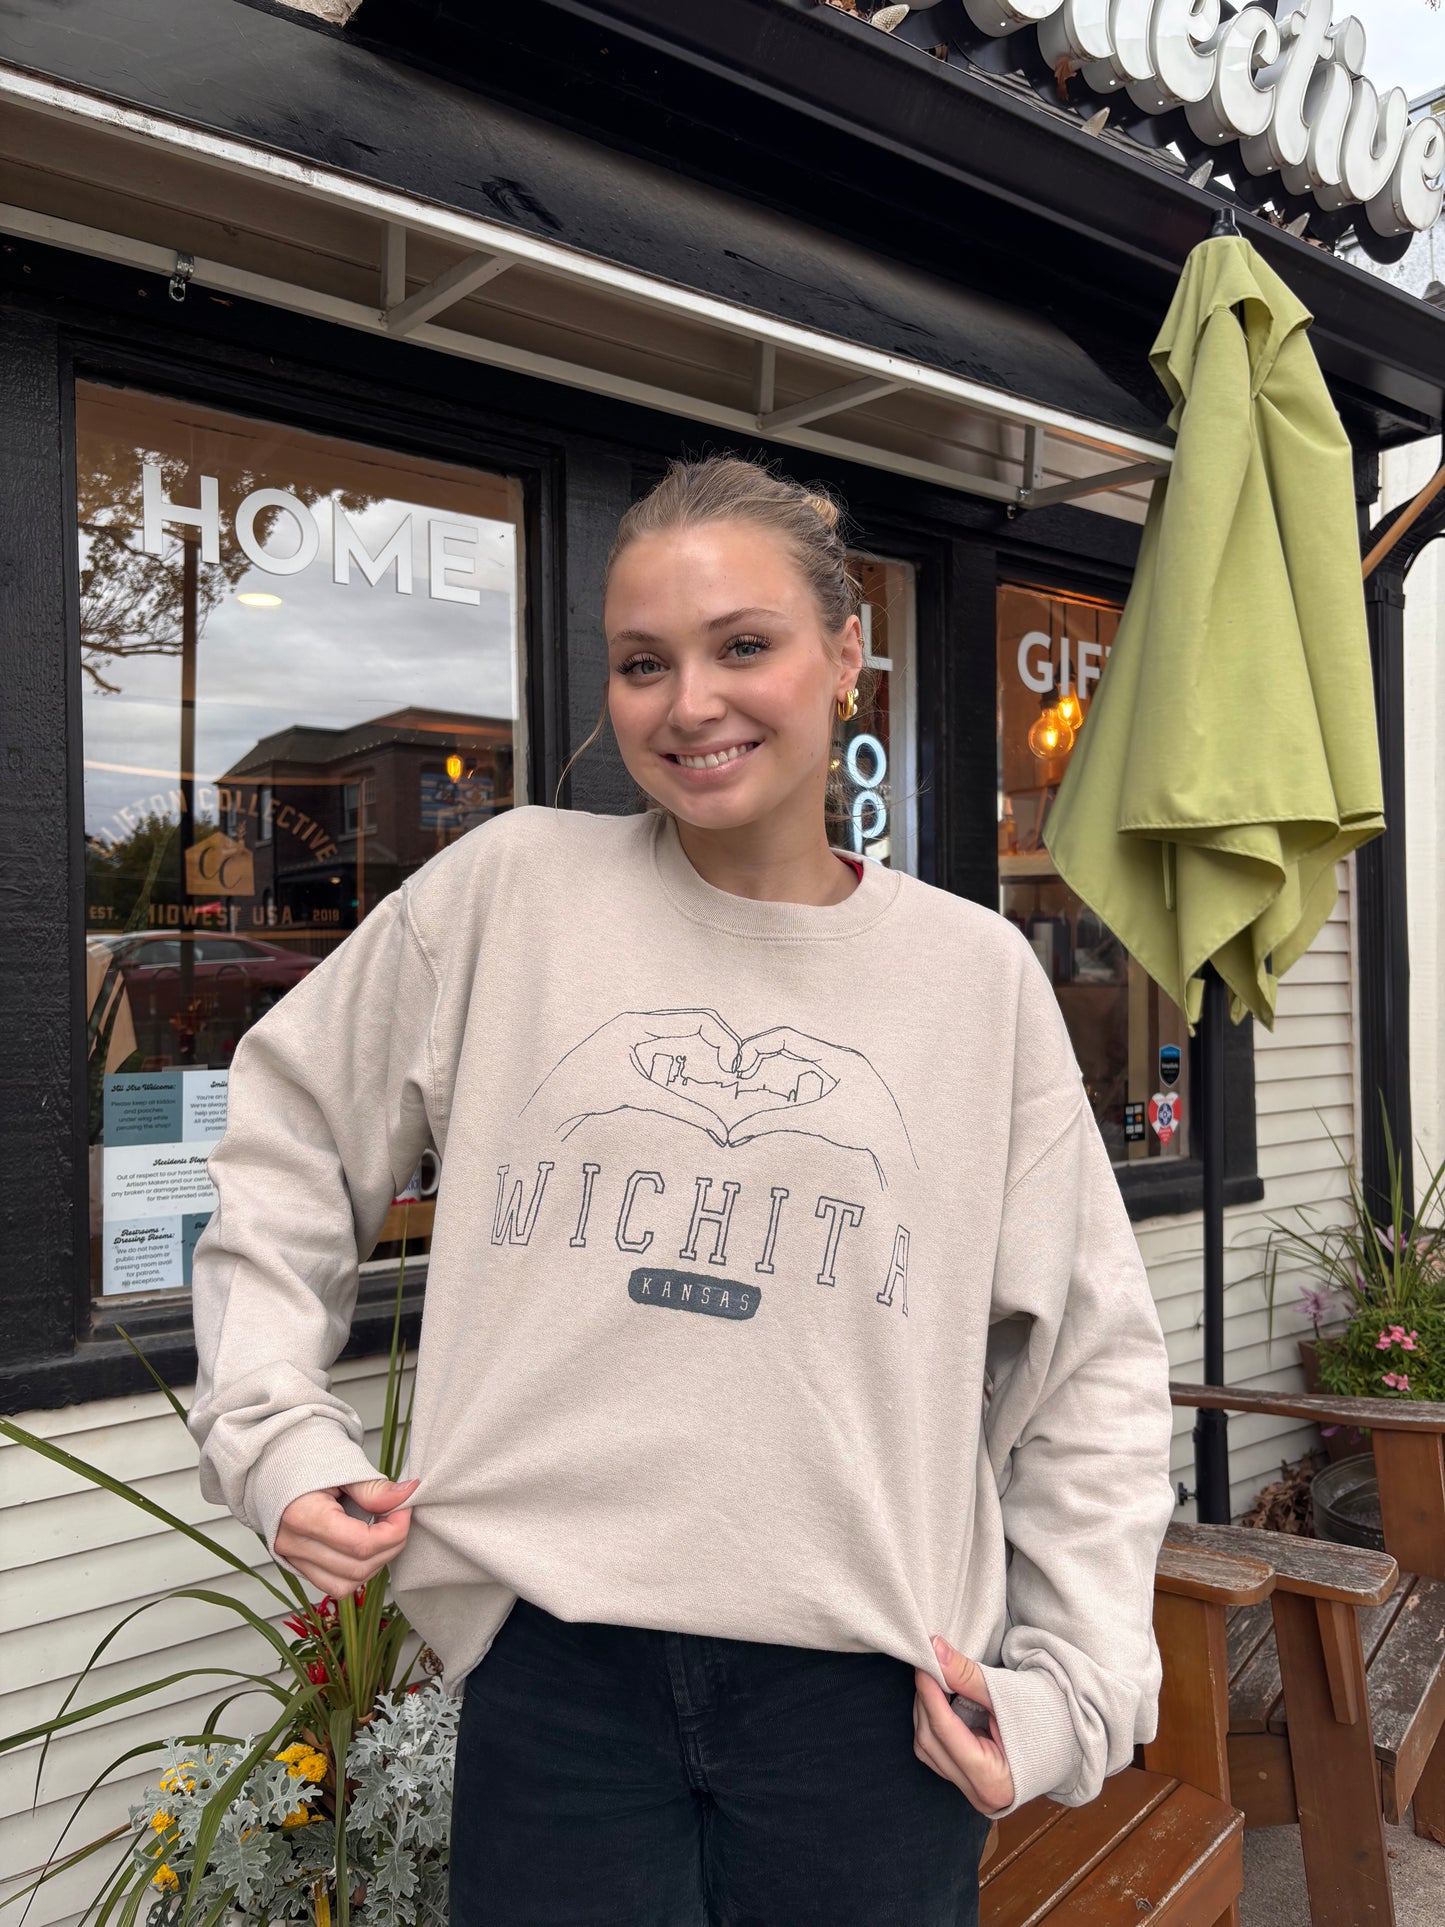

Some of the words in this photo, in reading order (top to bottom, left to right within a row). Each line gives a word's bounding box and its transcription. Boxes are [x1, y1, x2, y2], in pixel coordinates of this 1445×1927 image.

[142, 464, 481, 606] HOME
[198, 787, 338, 863] COLLECTIVE
[90, 905, 119, 920] EST.
[252, 905, 293, 926] USA
[202, 1116, 226, 1124] shoplifte
[126, 1180, 147, 1188] Artisan
[121, 1228, 159, 1236] Restrooms
[113, 1235, 145, 1244] Dressing
[491, 1161, 910, 1317] WICHITA
[116, 1256, 134, 1264] public
[114, 1263, 140, 1271] dressing
[641, 1277, 750, 1311] KANSAS
